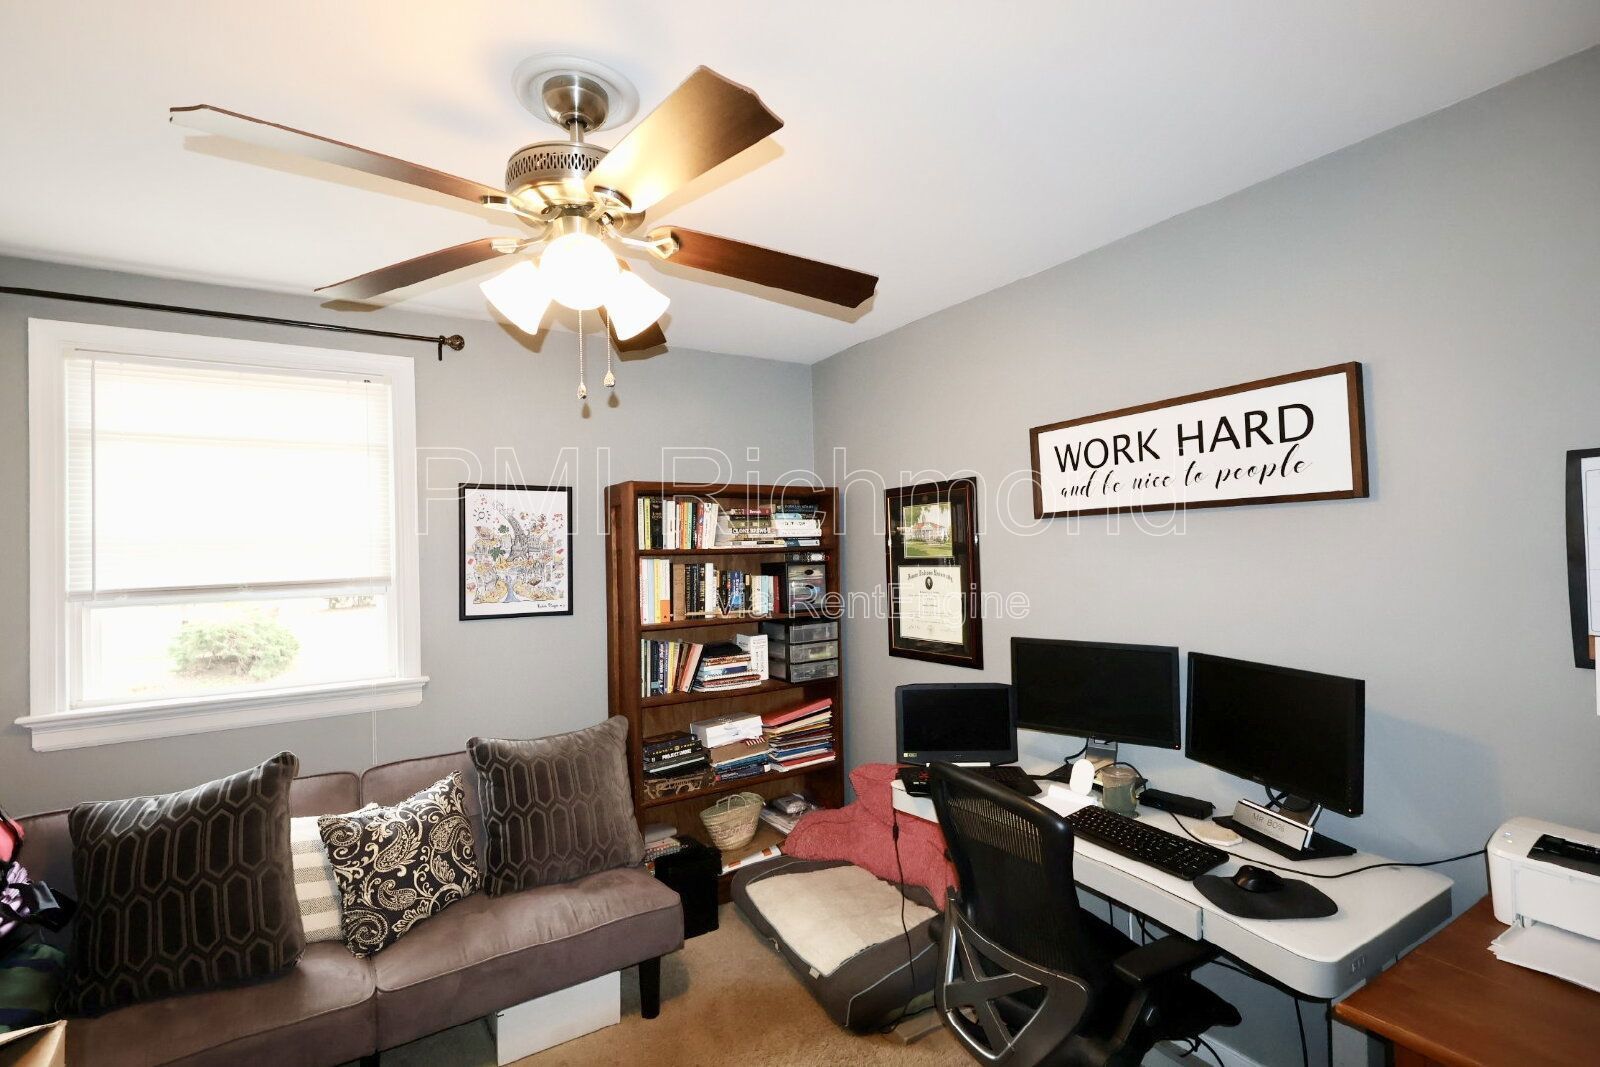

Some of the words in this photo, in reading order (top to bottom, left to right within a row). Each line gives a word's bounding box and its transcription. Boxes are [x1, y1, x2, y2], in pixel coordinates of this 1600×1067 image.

[1054, 428, 1160, 473] WORK
[1177, 403, 1314, 456] HARD
[1061, 469, 1097, 498] and
[1102, 468, 1121, 496] be
[1132, 470, 1175, 490] nice
[1184, 460, 1207, 486] to
[1214, 443, 1313, 490] people
